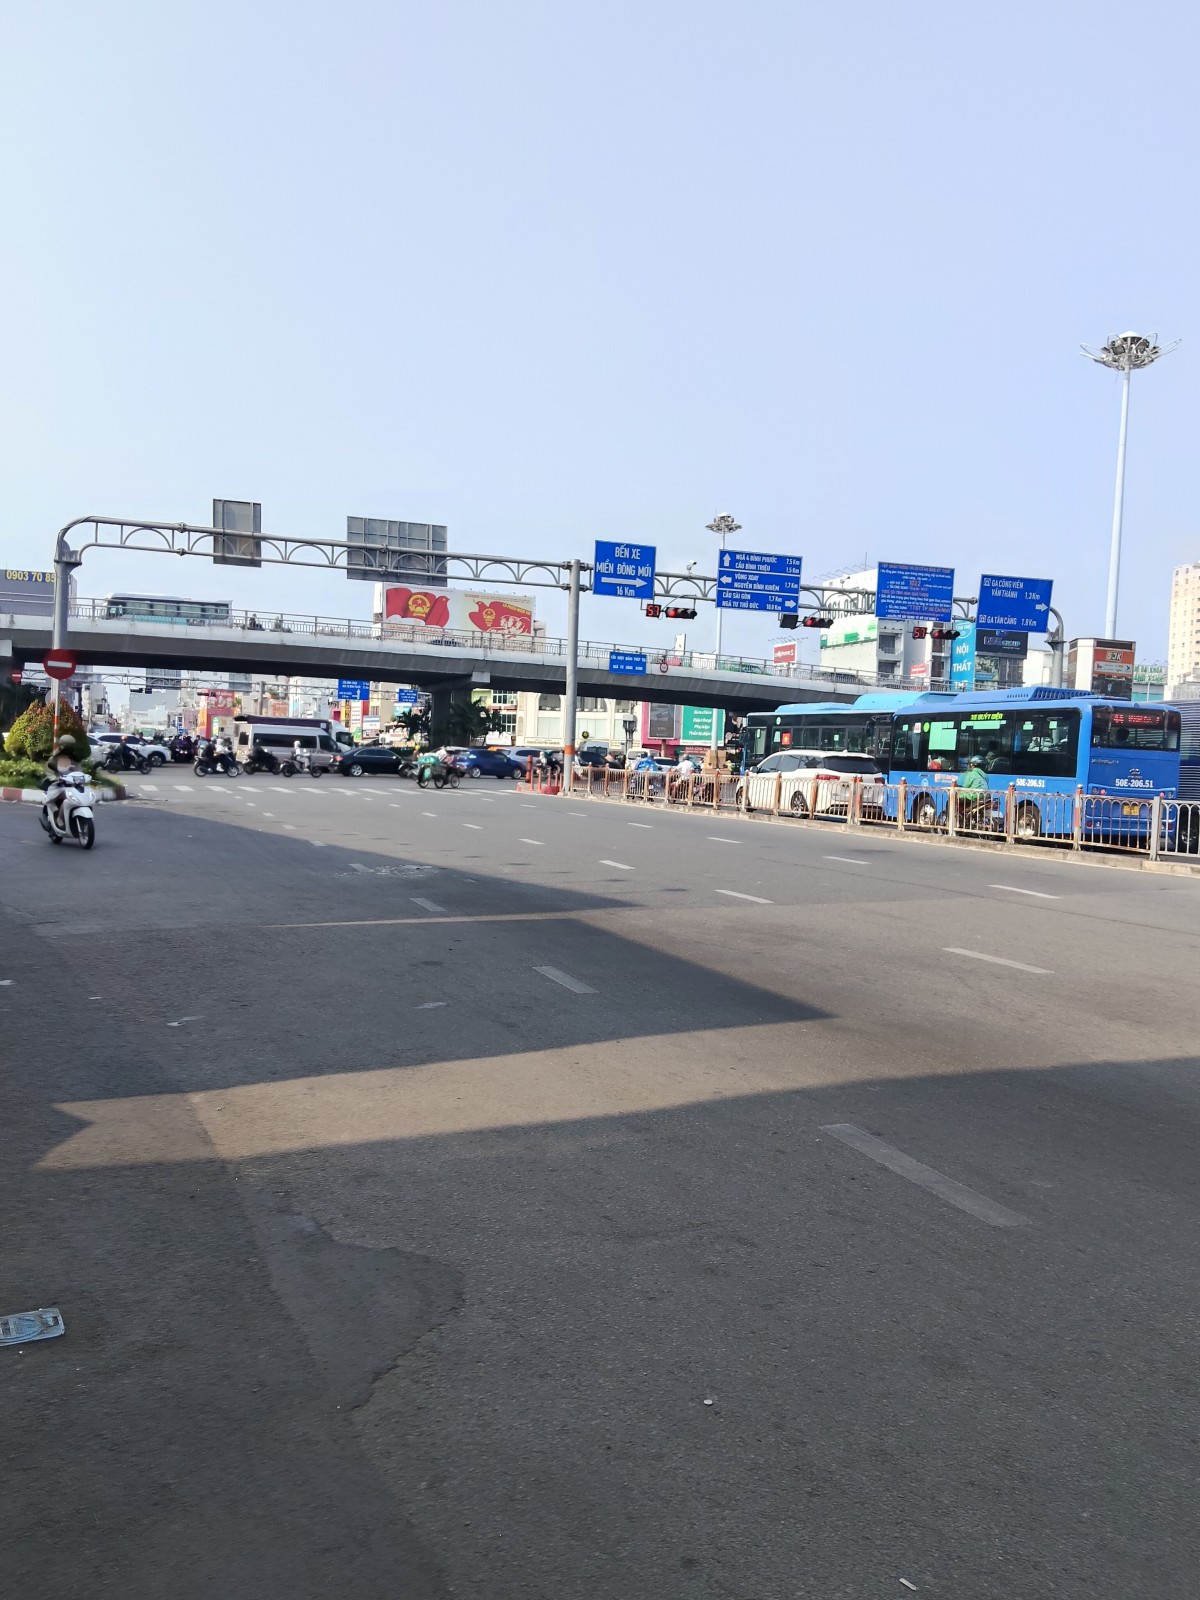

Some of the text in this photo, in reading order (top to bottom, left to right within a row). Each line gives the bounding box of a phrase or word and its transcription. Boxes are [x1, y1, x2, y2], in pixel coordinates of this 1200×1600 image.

[615, 544, 640, 560] BẾN XE
[596, 559, 651, 577] MIỀN ĐÔNG MỚI
[6, 570, 28, 580] 0903
[32, 572, 42, 581] 70
[617, 586, 635, 596] 16 Km
[914, 628, 926, 638] 57
[956, 643, 968, 656] NỘI
[953, 659, 972, 672] THẤT
[1115, 779, 1153, 788] 50E-206.51
